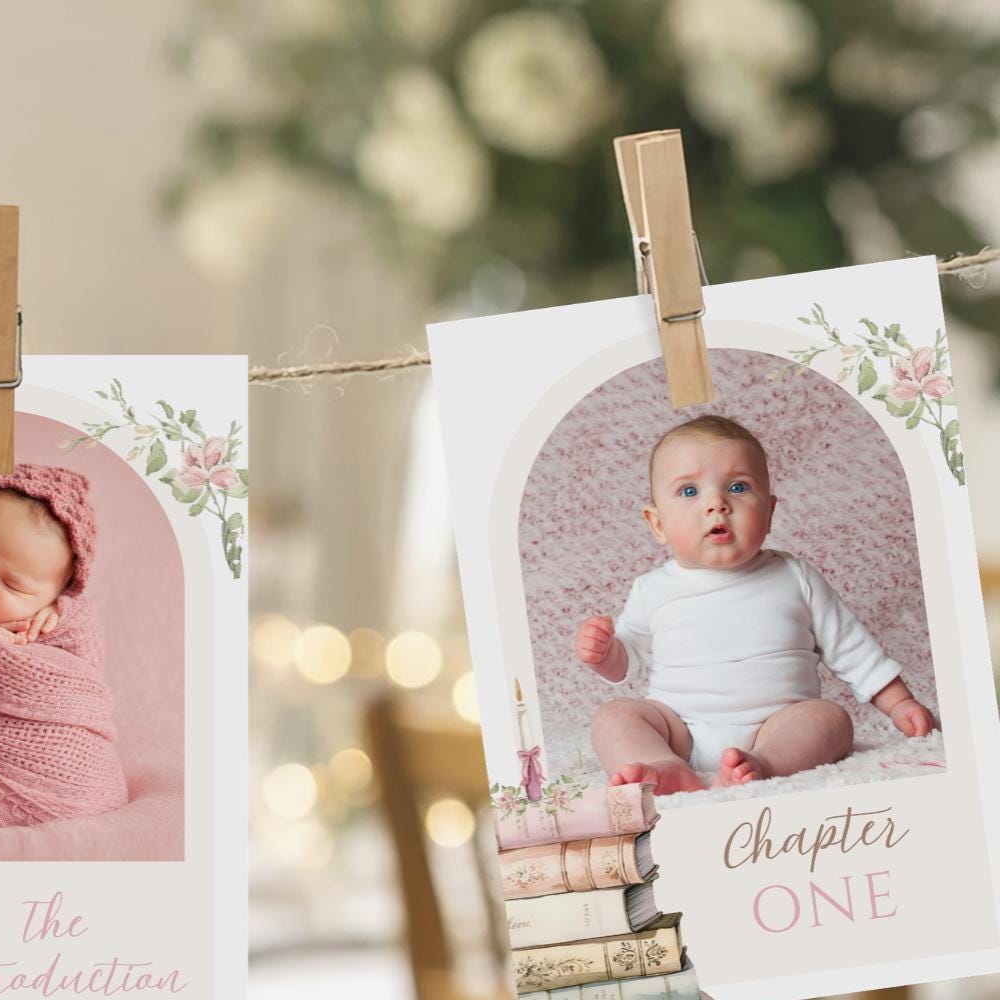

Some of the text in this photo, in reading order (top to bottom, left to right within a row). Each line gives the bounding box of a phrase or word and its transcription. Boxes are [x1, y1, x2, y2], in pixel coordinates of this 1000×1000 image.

[723, 806, 910, 873] Chapter
[21, 891, 89, 943] The
[752, 870, 897, 933] ONE
